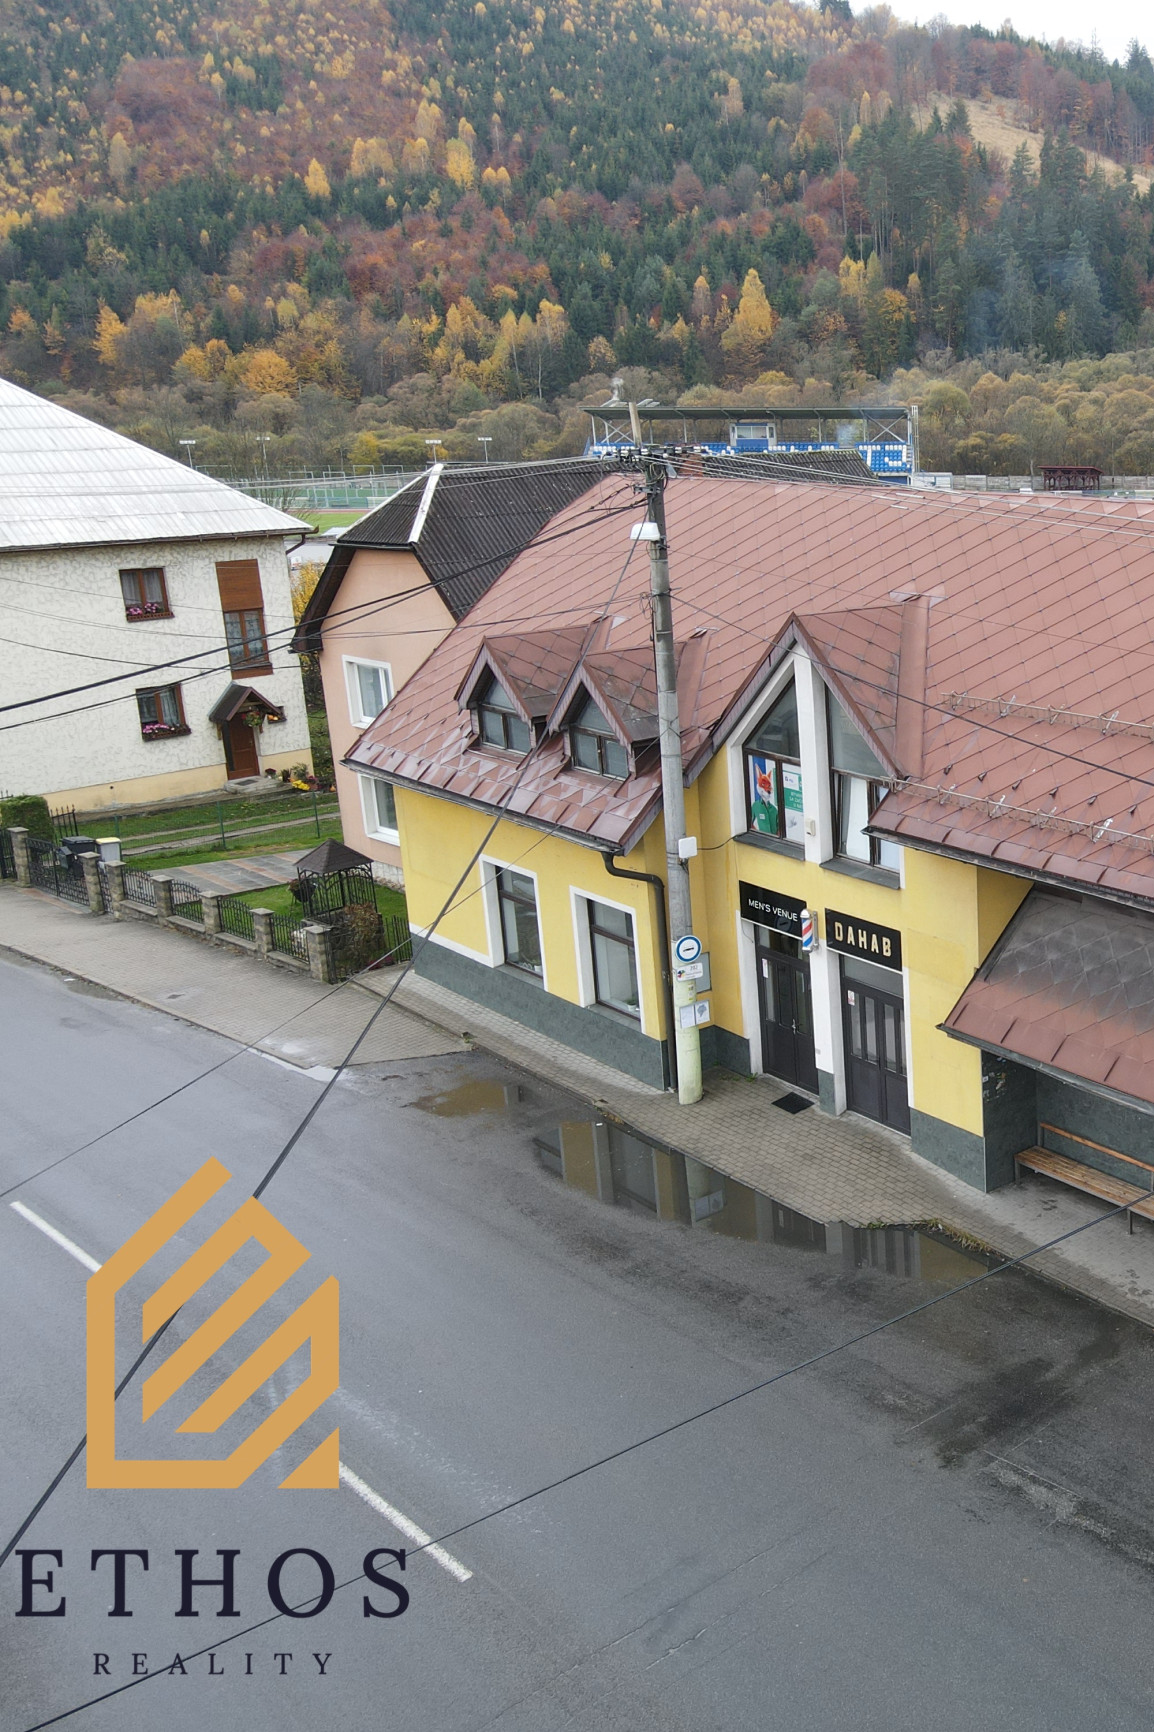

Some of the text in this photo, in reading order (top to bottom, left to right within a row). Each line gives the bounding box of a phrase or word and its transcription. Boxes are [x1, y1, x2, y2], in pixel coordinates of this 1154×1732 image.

[748, 898, 798, 922] MEN'S VENUE
[834, 921, 892, 957] DAHAB
